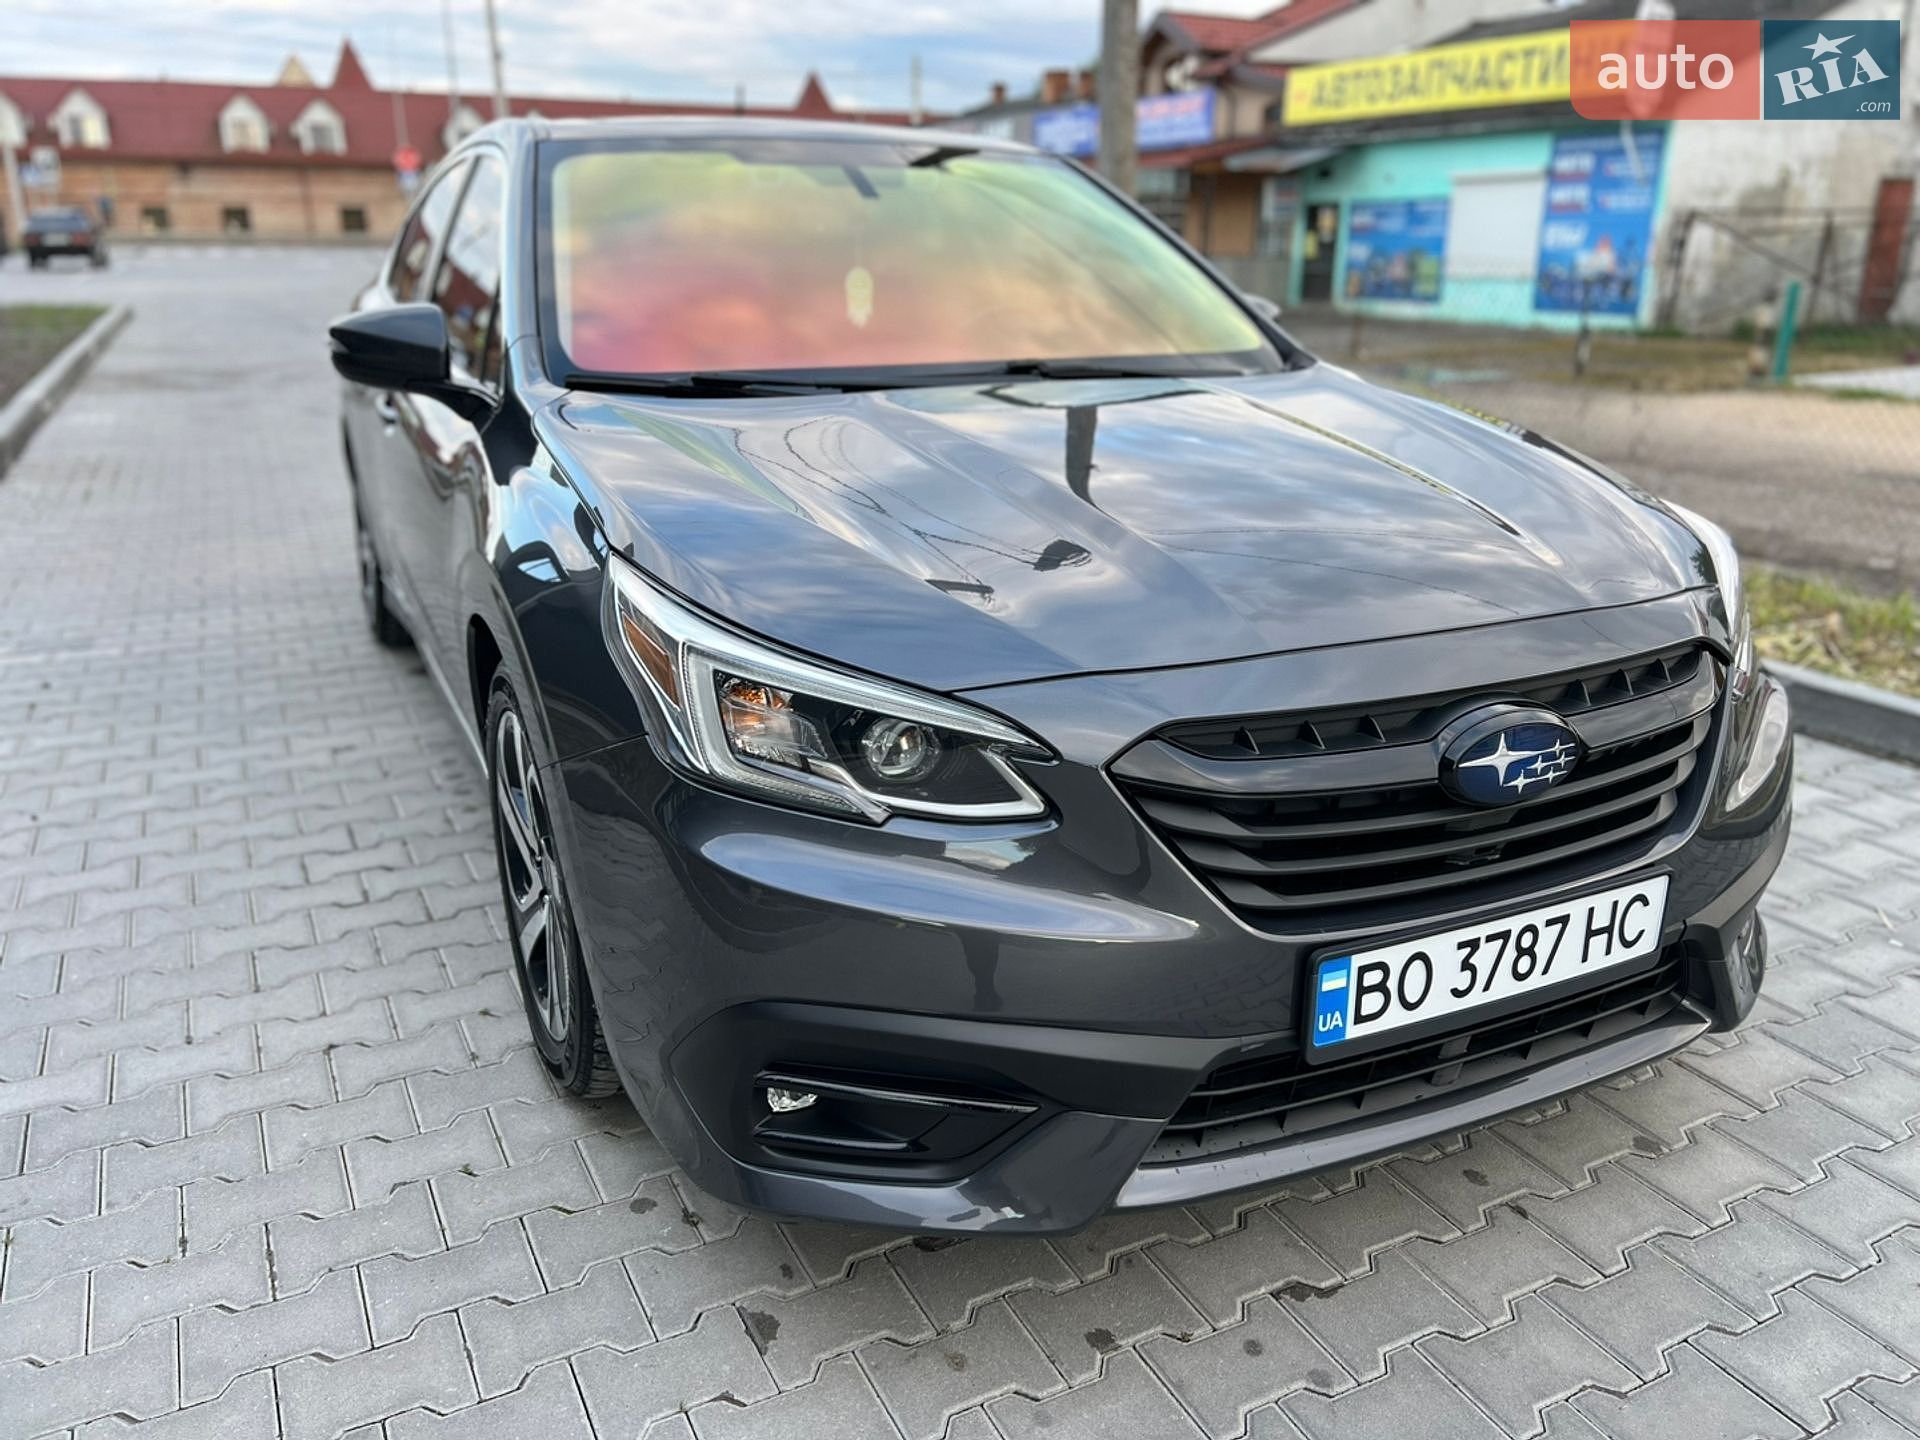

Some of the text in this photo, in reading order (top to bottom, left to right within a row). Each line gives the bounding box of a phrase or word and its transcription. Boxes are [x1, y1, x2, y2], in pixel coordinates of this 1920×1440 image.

[1352, 892, 1651, 1027] BO 3787 HC
[1317, 1009, 1344, 1033] UA
